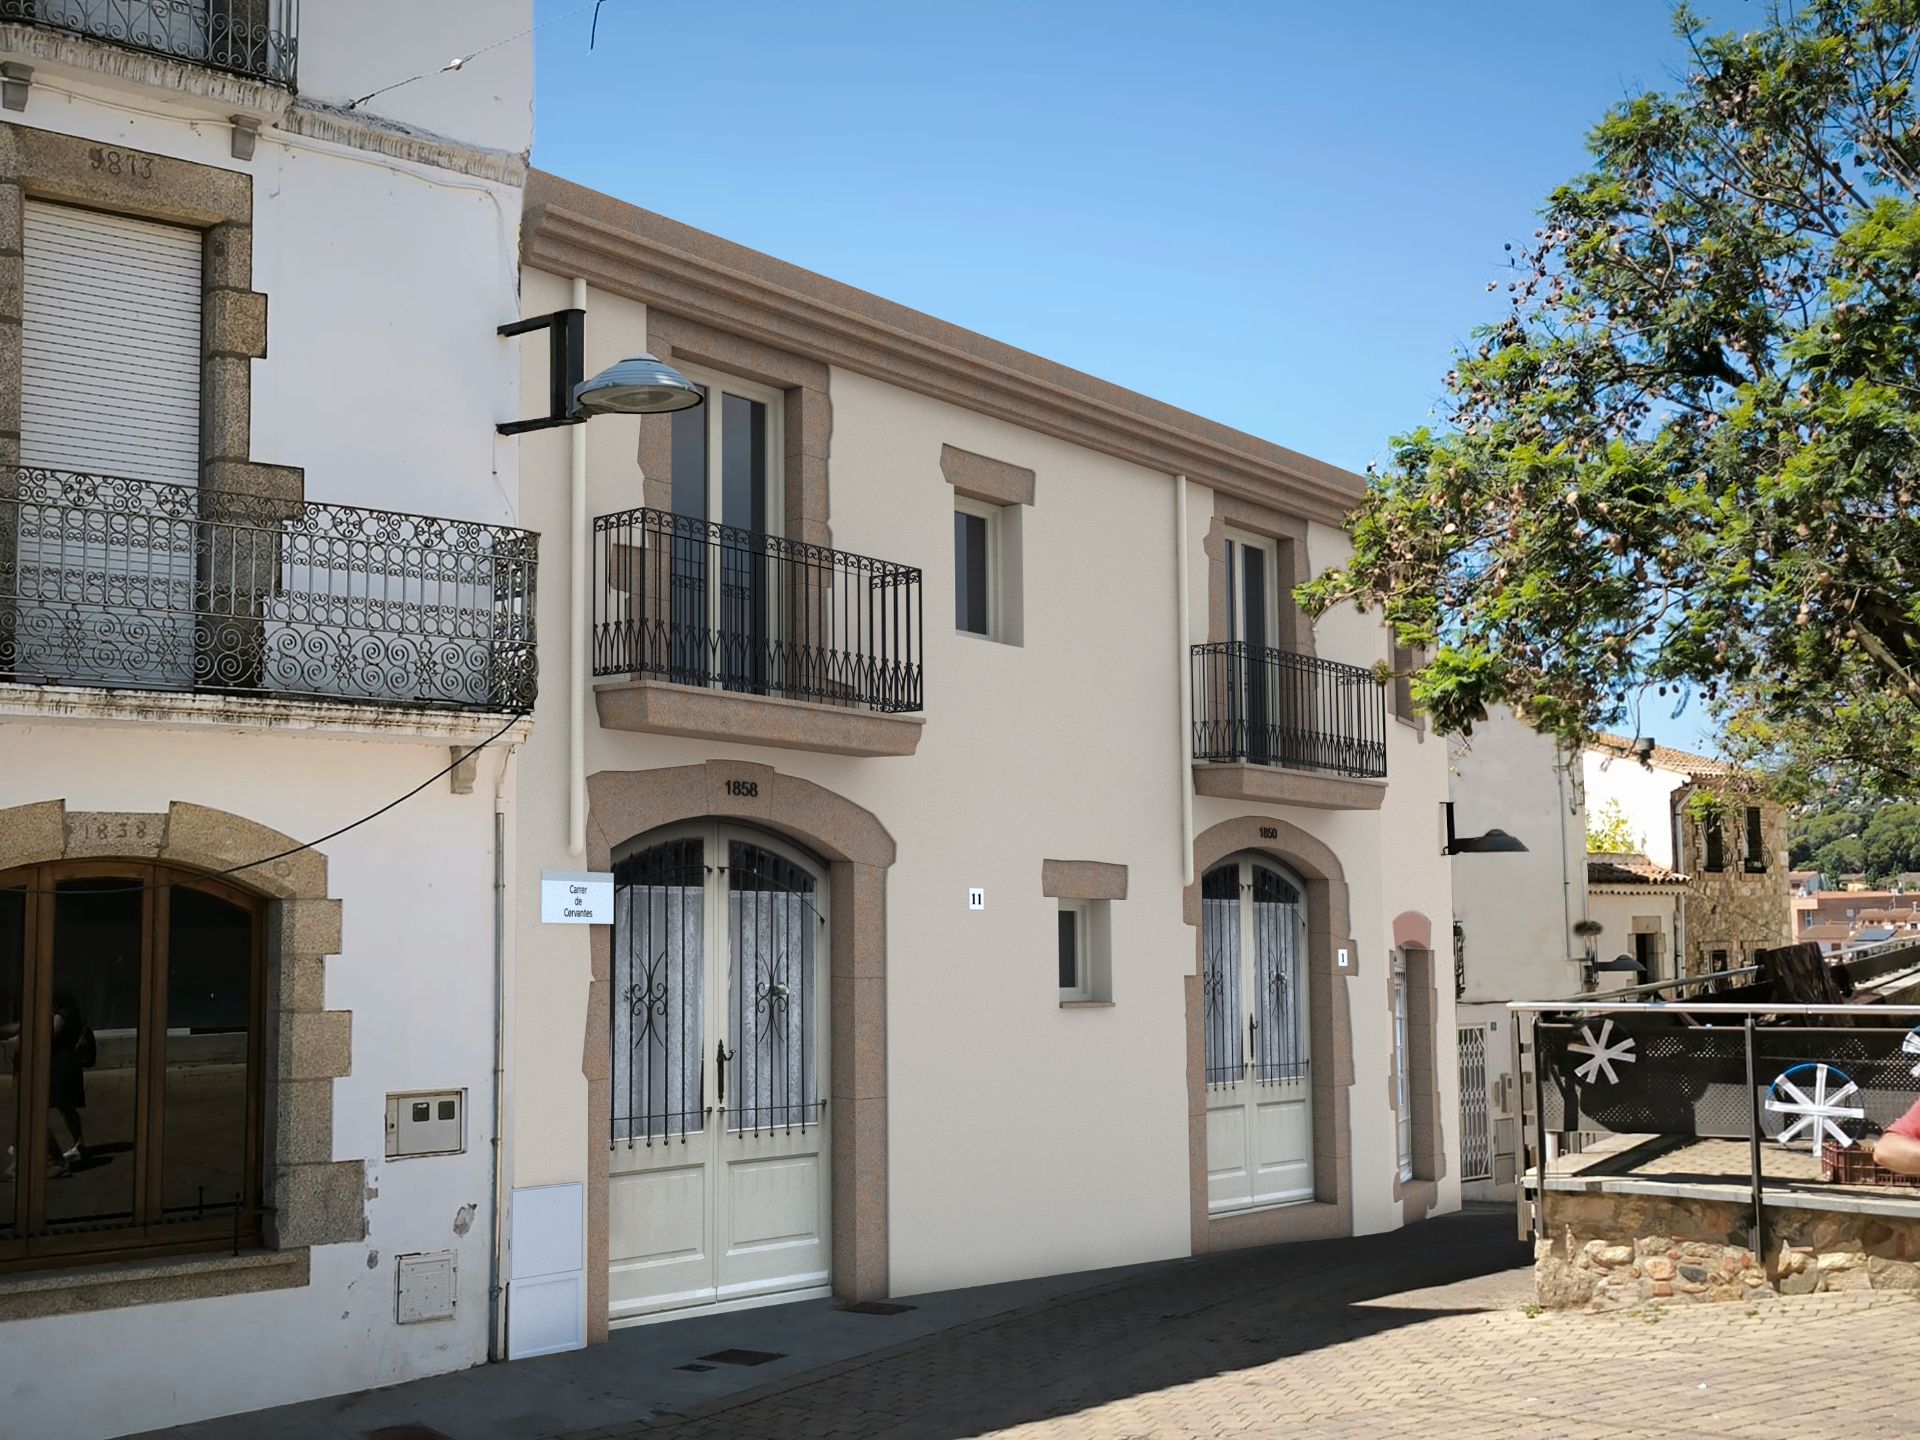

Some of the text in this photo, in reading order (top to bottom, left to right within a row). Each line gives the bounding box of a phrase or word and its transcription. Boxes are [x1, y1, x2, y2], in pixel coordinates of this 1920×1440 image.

[725, 779, 759, 798] 1858
[84, 821, 147, 840] 1838
[569, 884, 588, 894] Carrer
[574, 896, 583, 906] de
[971, 893, 982, 905] 11
[563, 907, 593, 918] Cervantes
